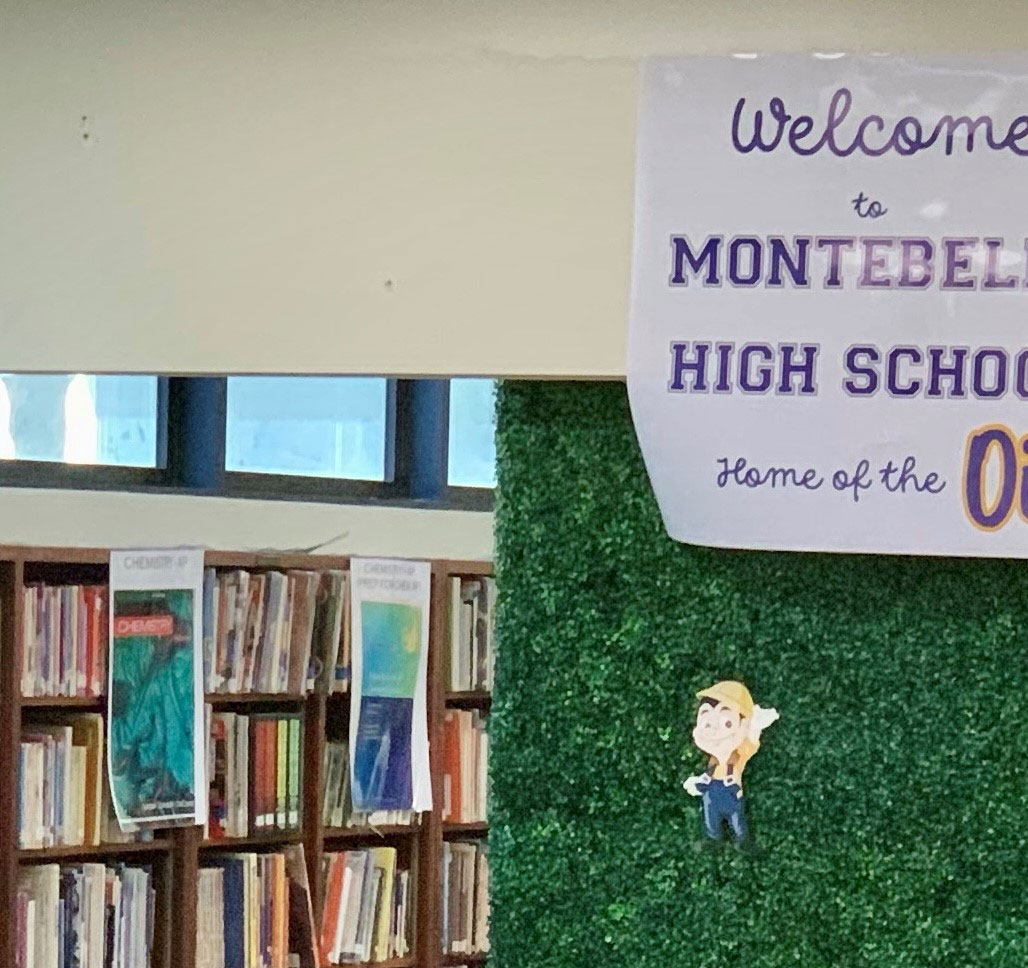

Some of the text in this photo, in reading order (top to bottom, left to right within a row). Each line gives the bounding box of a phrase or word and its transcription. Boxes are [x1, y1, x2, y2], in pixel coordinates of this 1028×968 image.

[851, 191, 888, 219] to
[667, 340, 821, 397] HIGH
[716, 457, 824, 491] Home
[832, 459, 873, 502] of
[879, 456, 947, 495] the
